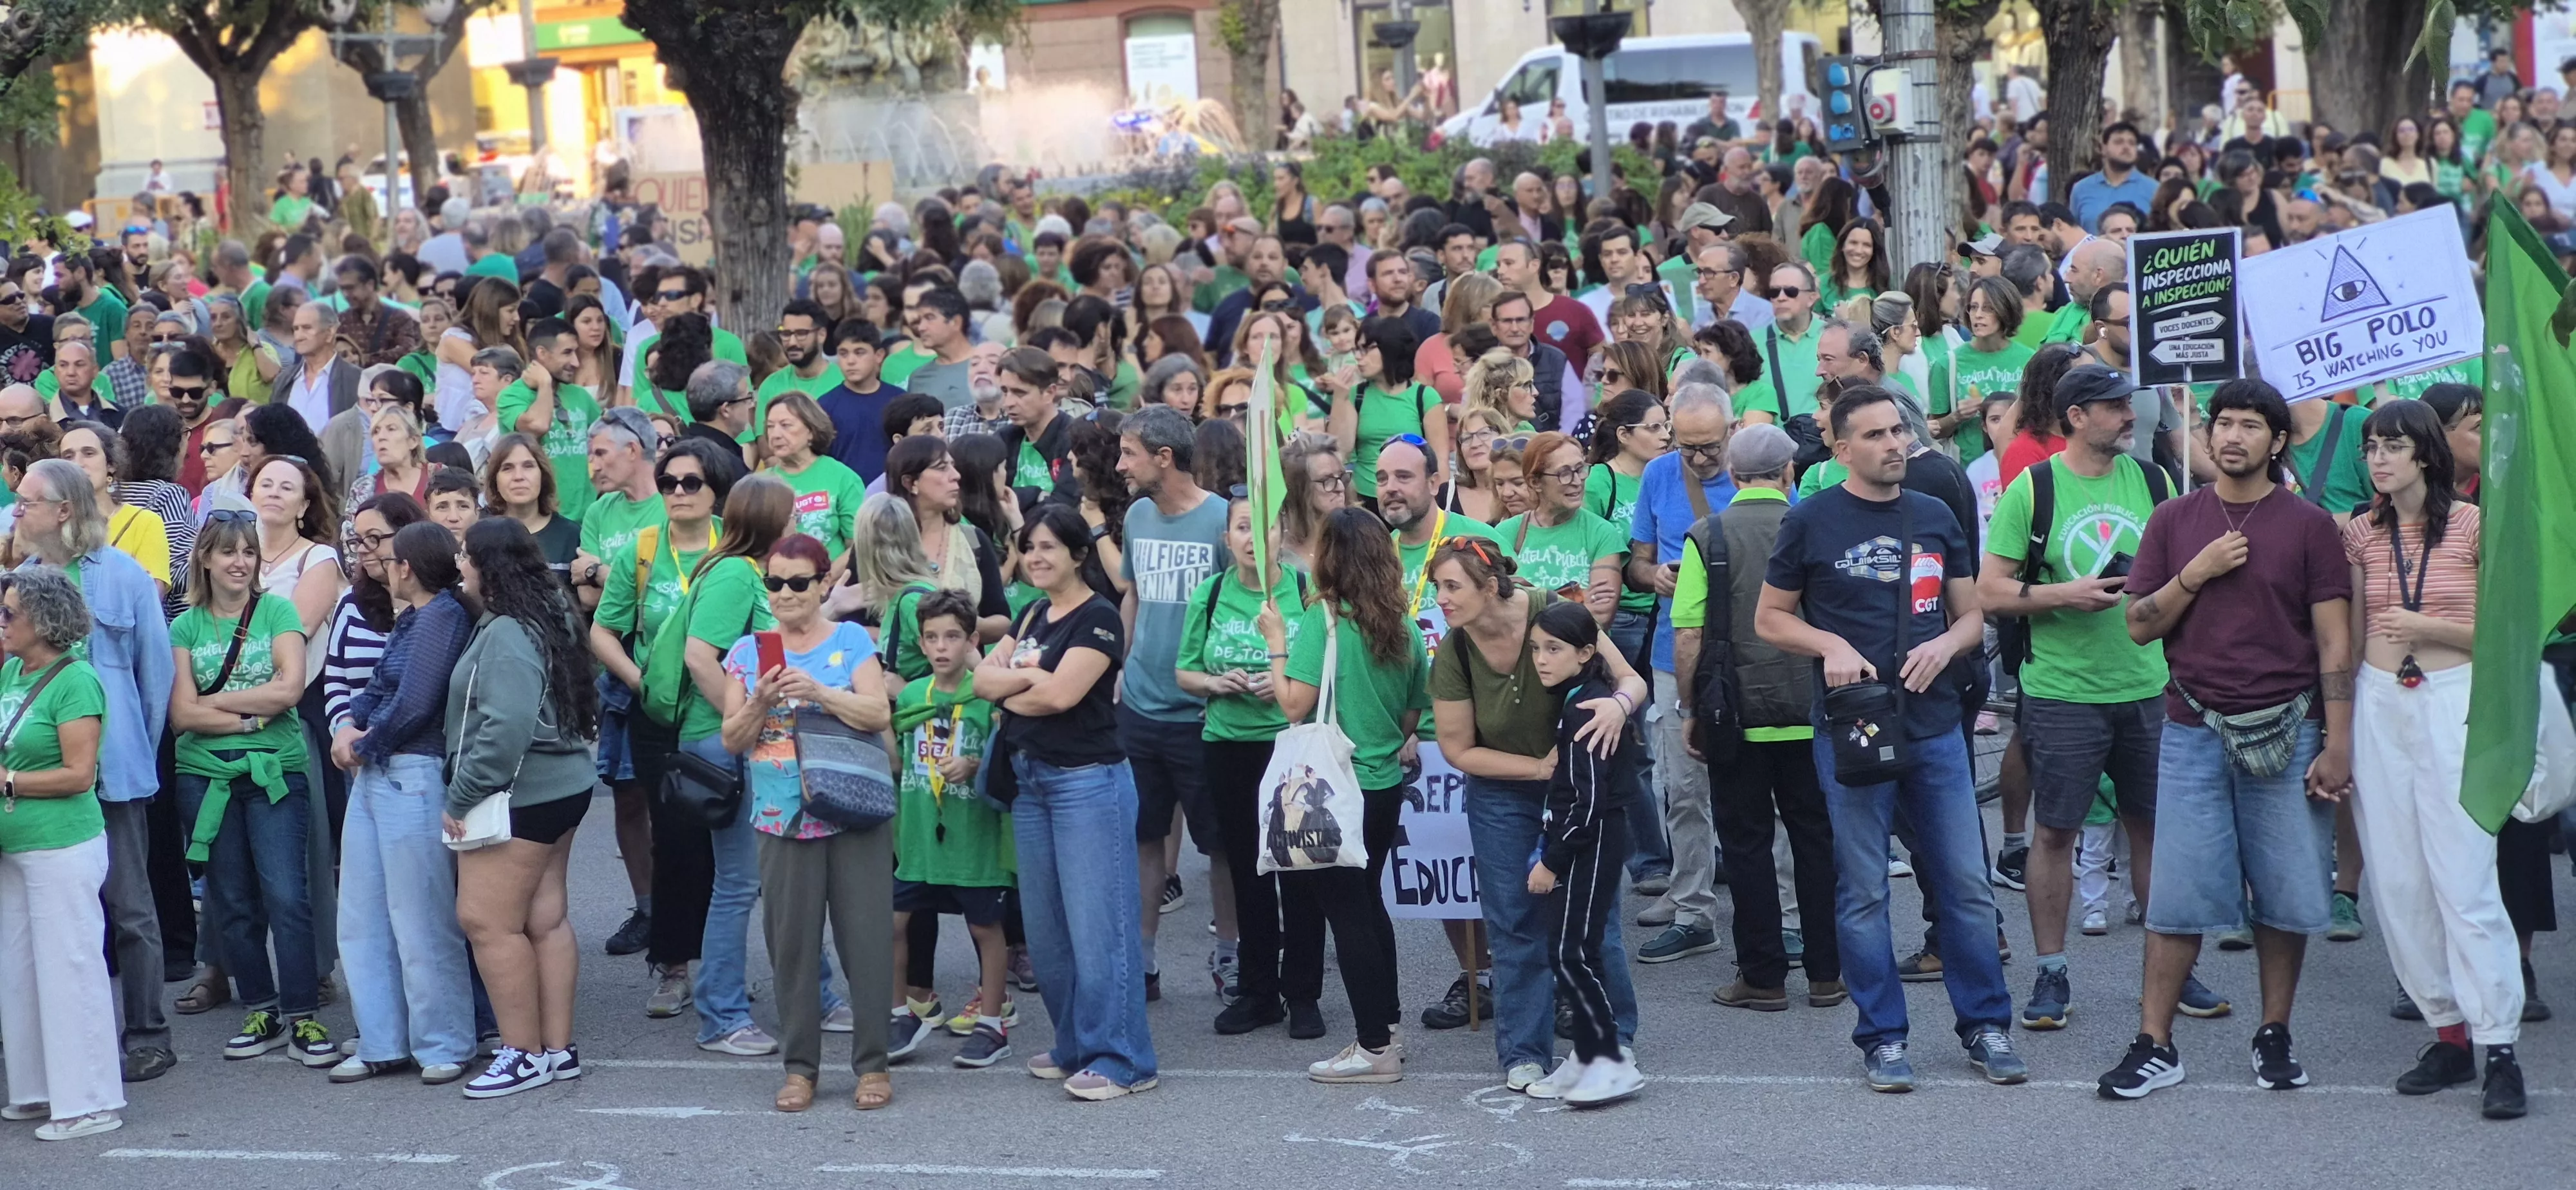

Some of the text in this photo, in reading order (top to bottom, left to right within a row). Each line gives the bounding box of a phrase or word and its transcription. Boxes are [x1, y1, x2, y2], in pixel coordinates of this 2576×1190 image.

[2143, 238, 2215, 274] ¿QUIÉN
[2143, 258, 2232, 291] INSPECCIONA
[2141, 276, 2232, 308] A INSPECCIÓN?
[2159, 316, 2214, 333] VOCES DOCENTES
[2295, 306, 2437, 366] BIG POLO
[2293, 330, 2448, 390] IS WATCHING YOU
[795, 496, 813, 509] UGT
[2058, 502, 2139, 542] EDUCACIÓN PÚBLICA
[1139, 571, 1179, 602] ENIM
[1915, 597, 1938, 613] CGT
[1213, 645, 1235, 659] DE
[196, 668, 215, 684] DE
